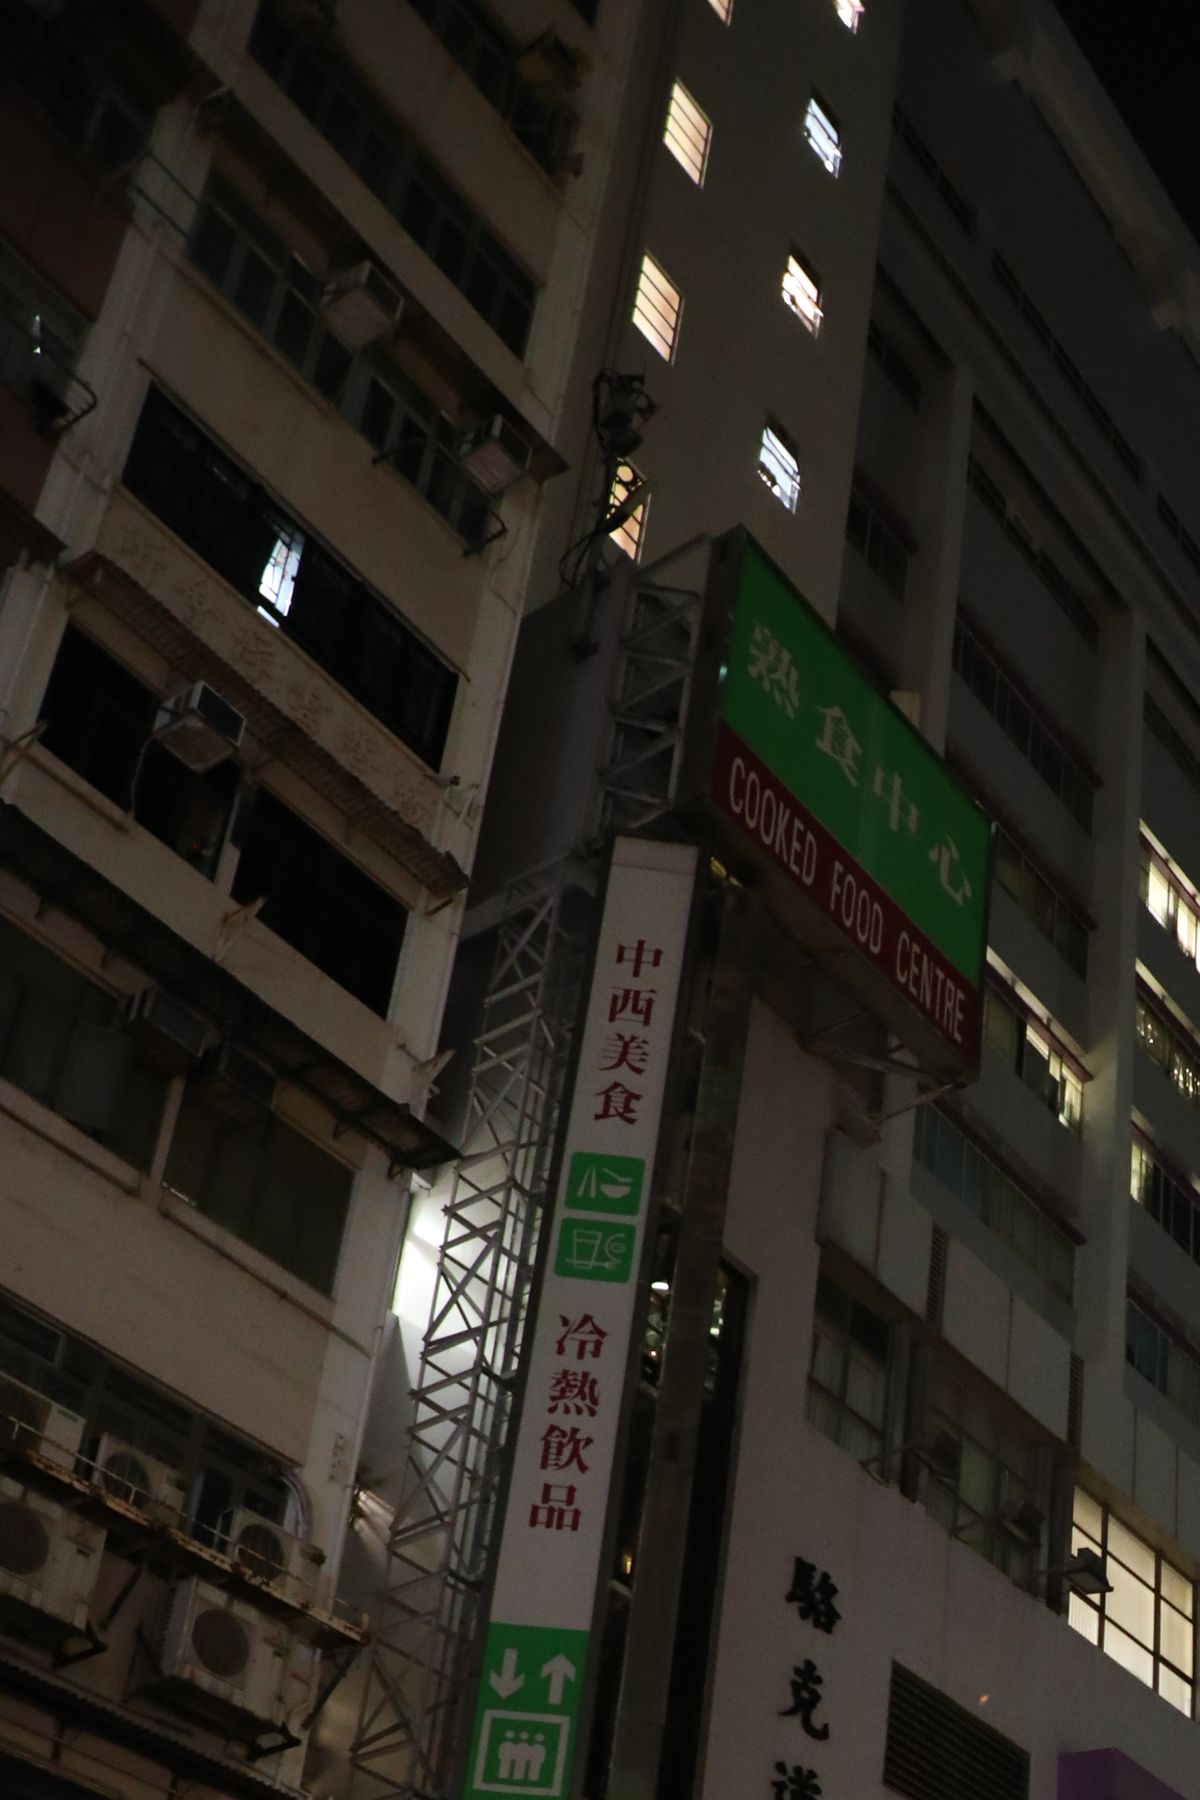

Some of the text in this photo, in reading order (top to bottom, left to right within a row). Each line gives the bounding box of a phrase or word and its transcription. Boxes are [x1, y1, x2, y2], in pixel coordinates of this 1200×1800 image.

[746, 620, 972, 906] 熟食中心
[728, 757, 965, 1044] COOKED FOOD CENTRE
[594, 939, 663, 1126] 中西美食
[528, 1313, 608, 1532] 冷熱飲品
